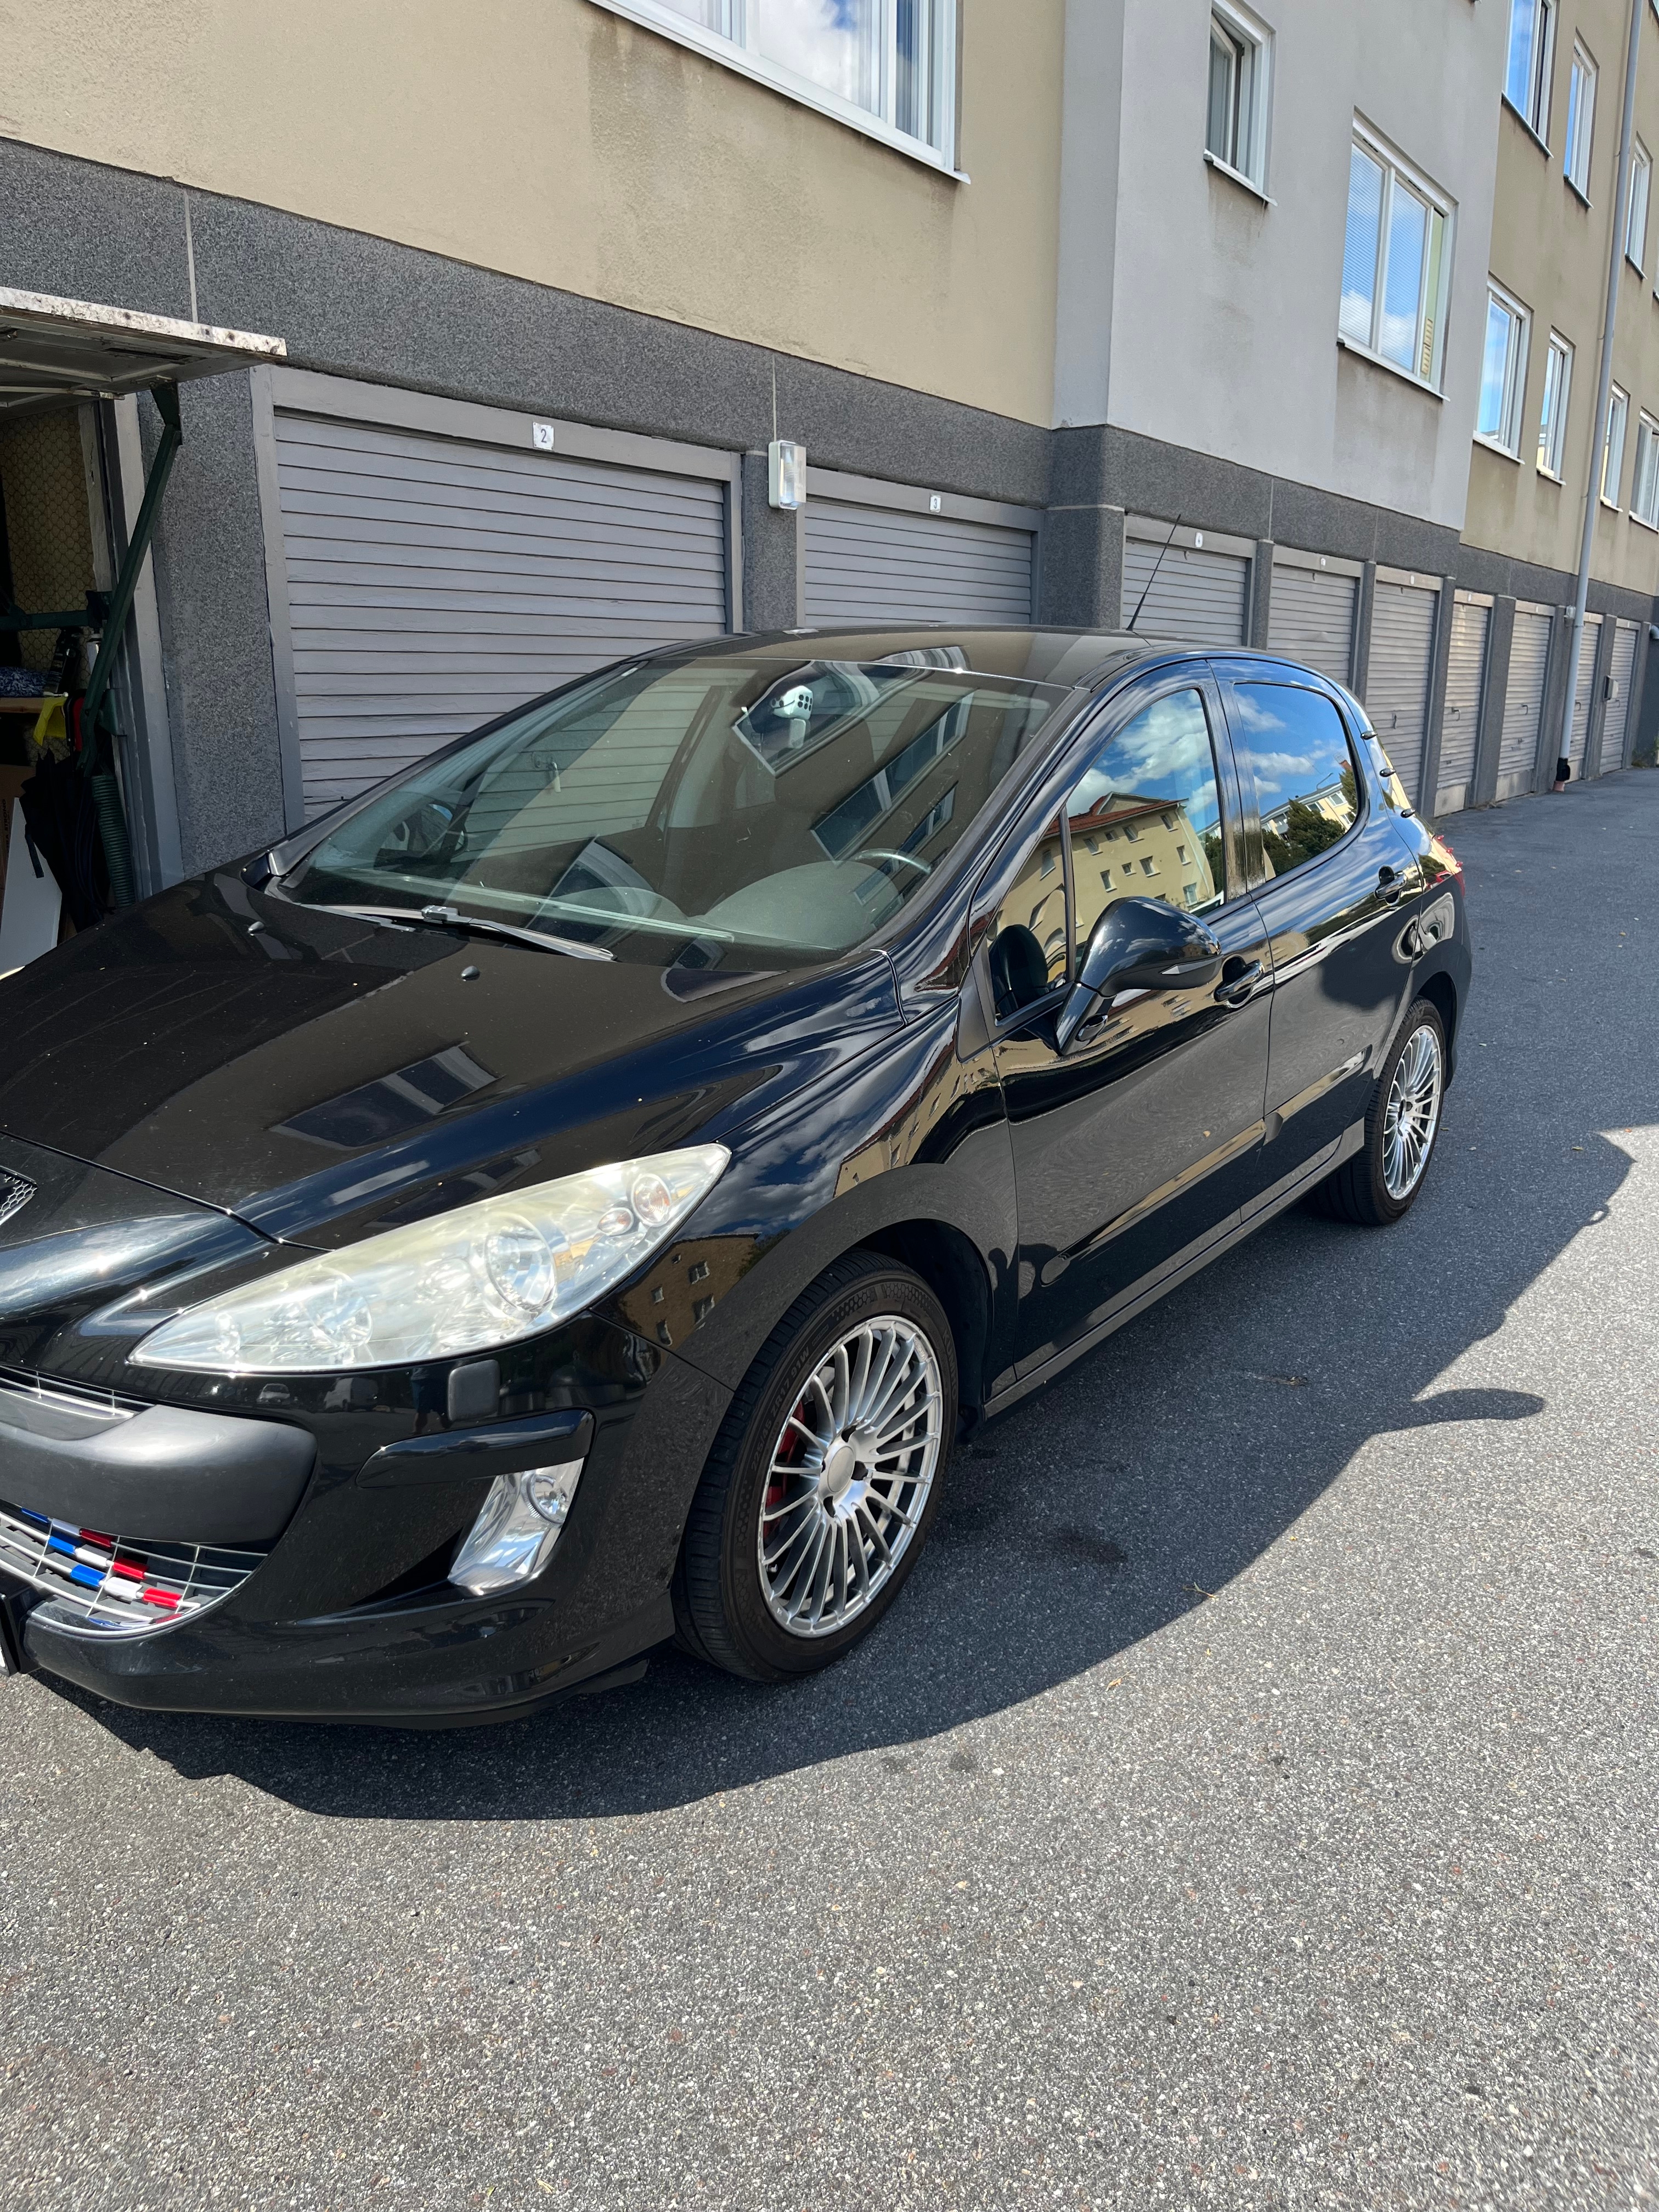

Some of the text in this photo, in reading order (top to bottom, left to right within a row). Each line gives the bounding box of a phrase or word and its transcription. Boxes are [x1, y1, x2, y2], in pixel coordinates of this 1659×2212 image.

[540, 428, 547, 443] 2
[942, 1328, 957, 1400] KUMHO
[751, 1346, 810, 1472] 225/45 ZR17 91W
